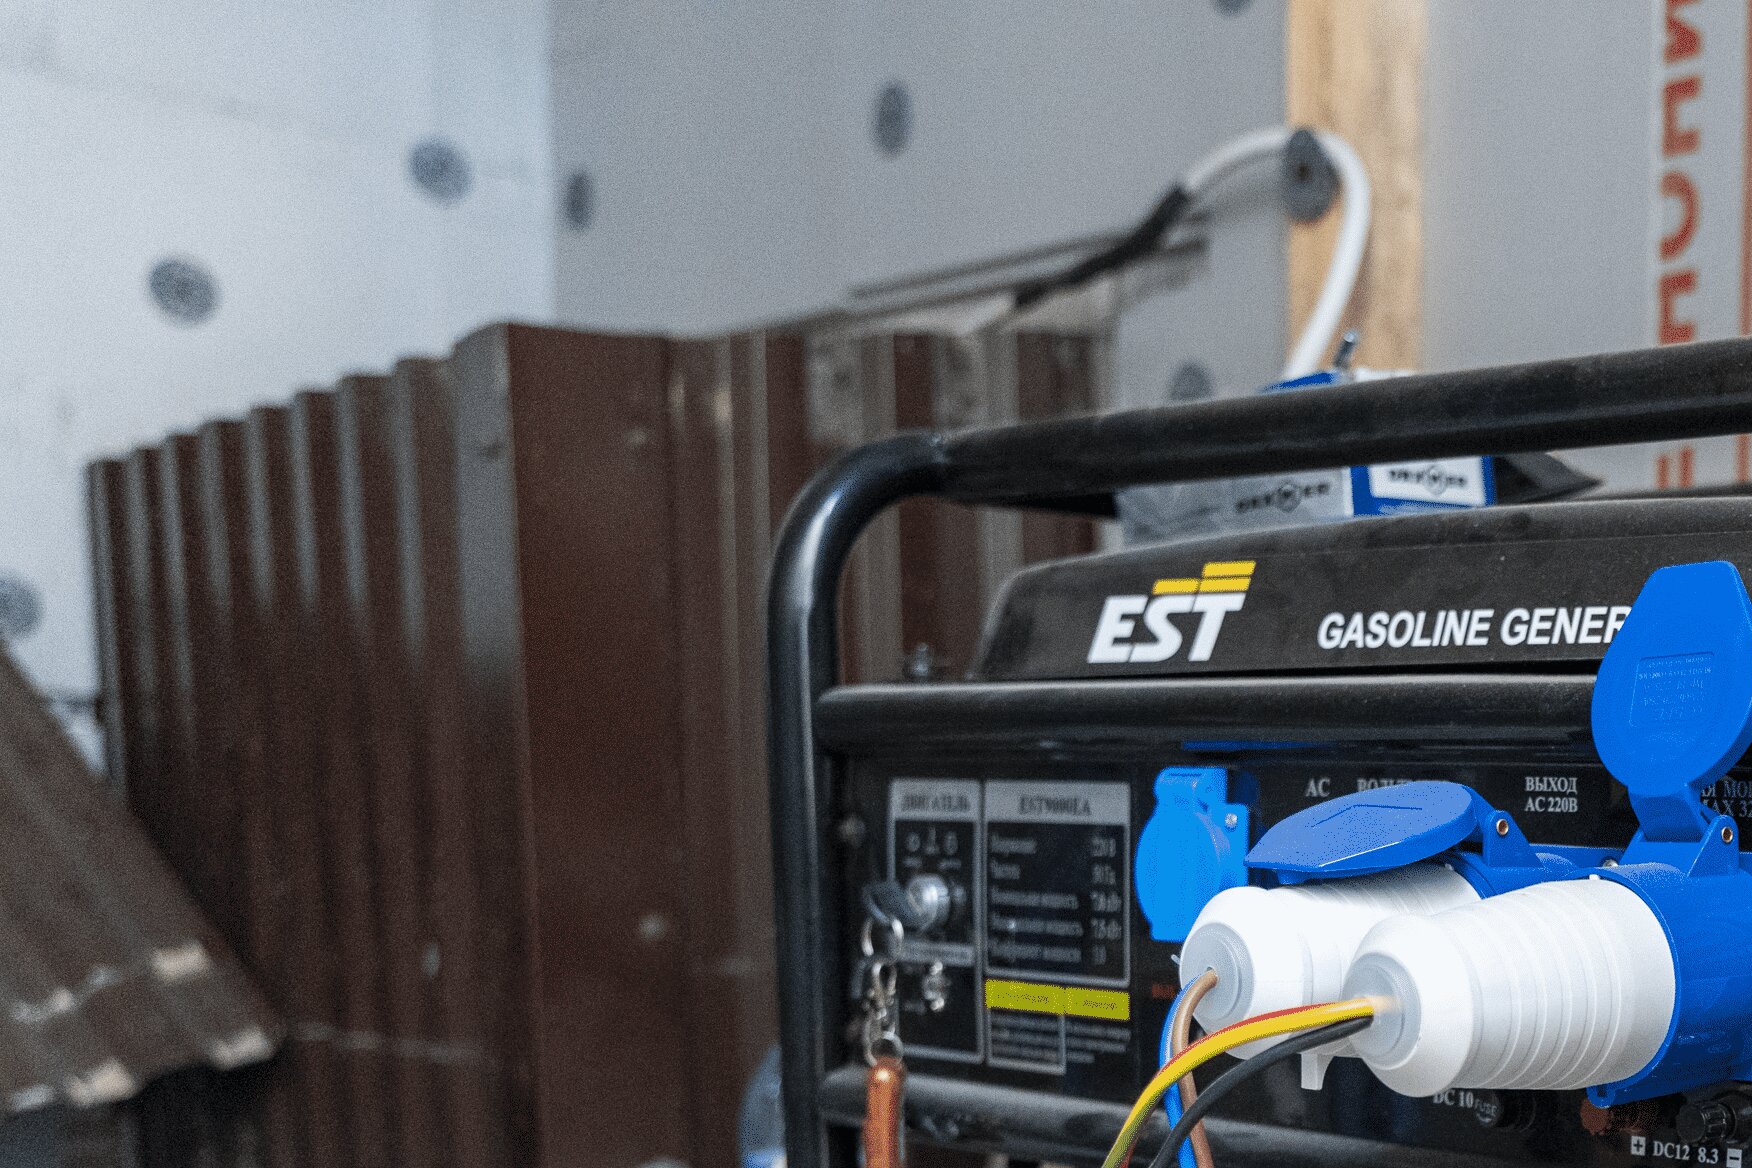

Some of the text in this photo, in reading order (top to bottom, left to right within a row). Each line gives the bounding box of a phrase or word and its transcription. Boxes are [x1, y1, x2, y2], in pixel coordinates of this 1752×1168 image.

[1087, 592, 1246, 664] EST
[1318, 605, 1631, 650] GASOLINE GENER
[1525, 776, 1578, 796] ВЫХОД
[1459, 1090, 1474, 1108] 10
[1652, 1140, 1719, 1165] DC12 8.3
